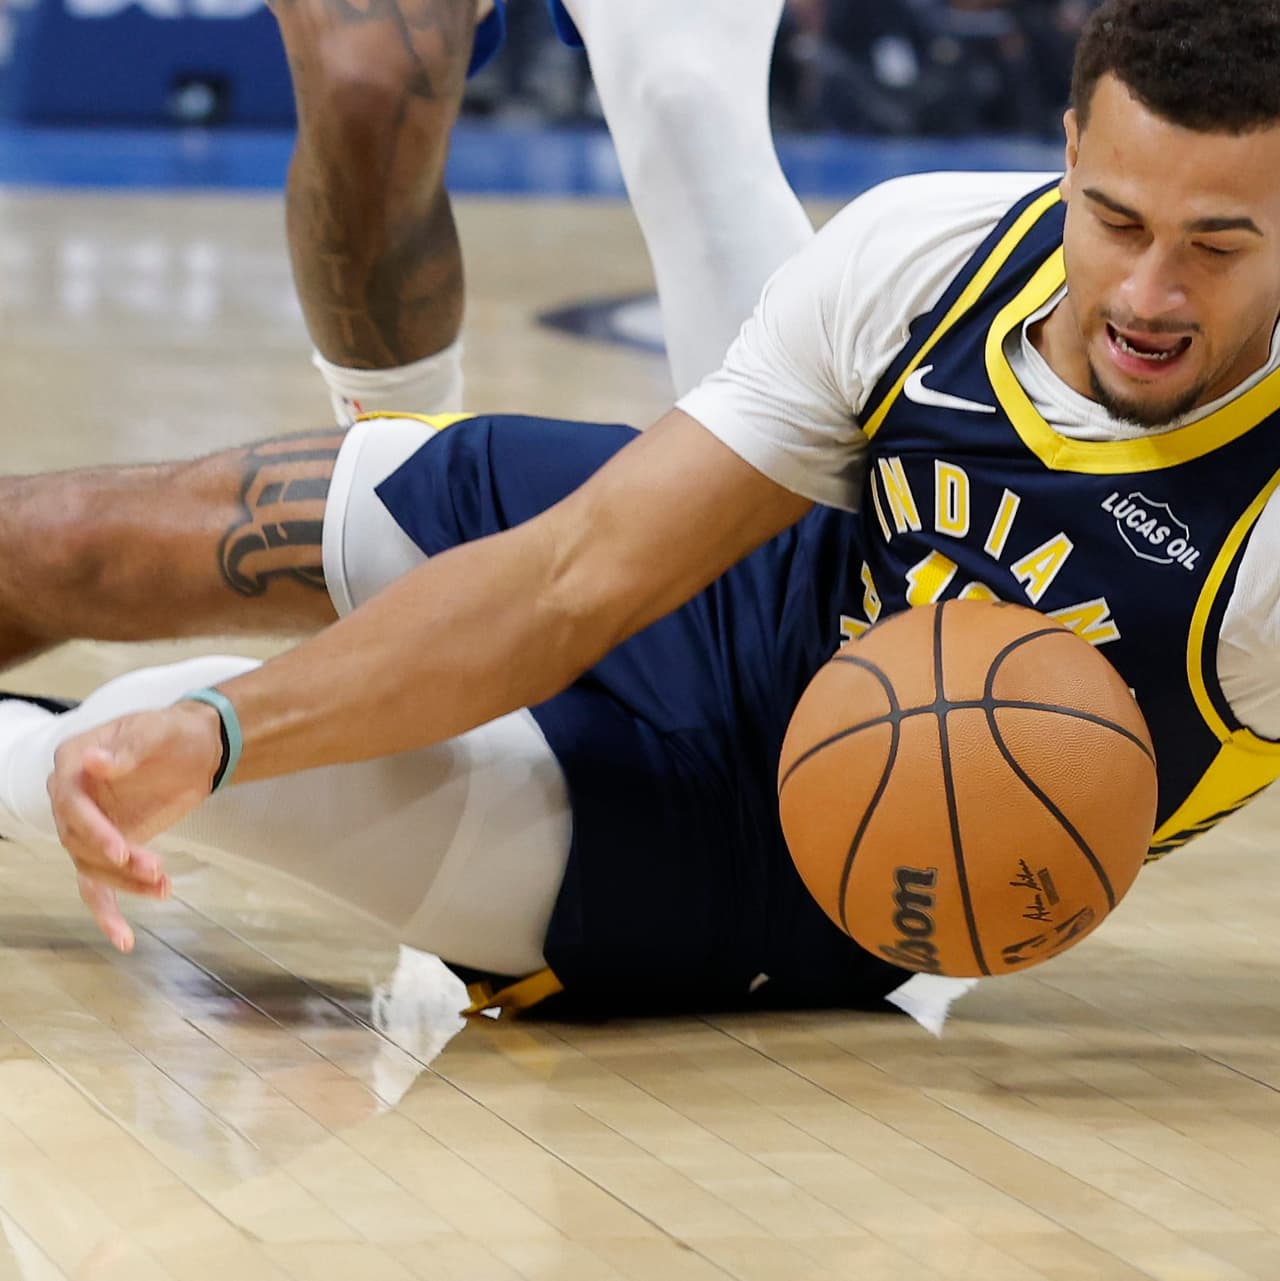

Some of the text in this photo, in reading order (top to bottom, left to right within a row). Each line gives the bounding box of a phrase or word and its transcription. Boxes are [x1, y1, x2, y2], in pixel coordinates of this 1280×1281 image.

[870, 456, 1122, 646] INDIAN
[1101, 491, 1200, 571] LUCAS OIL
